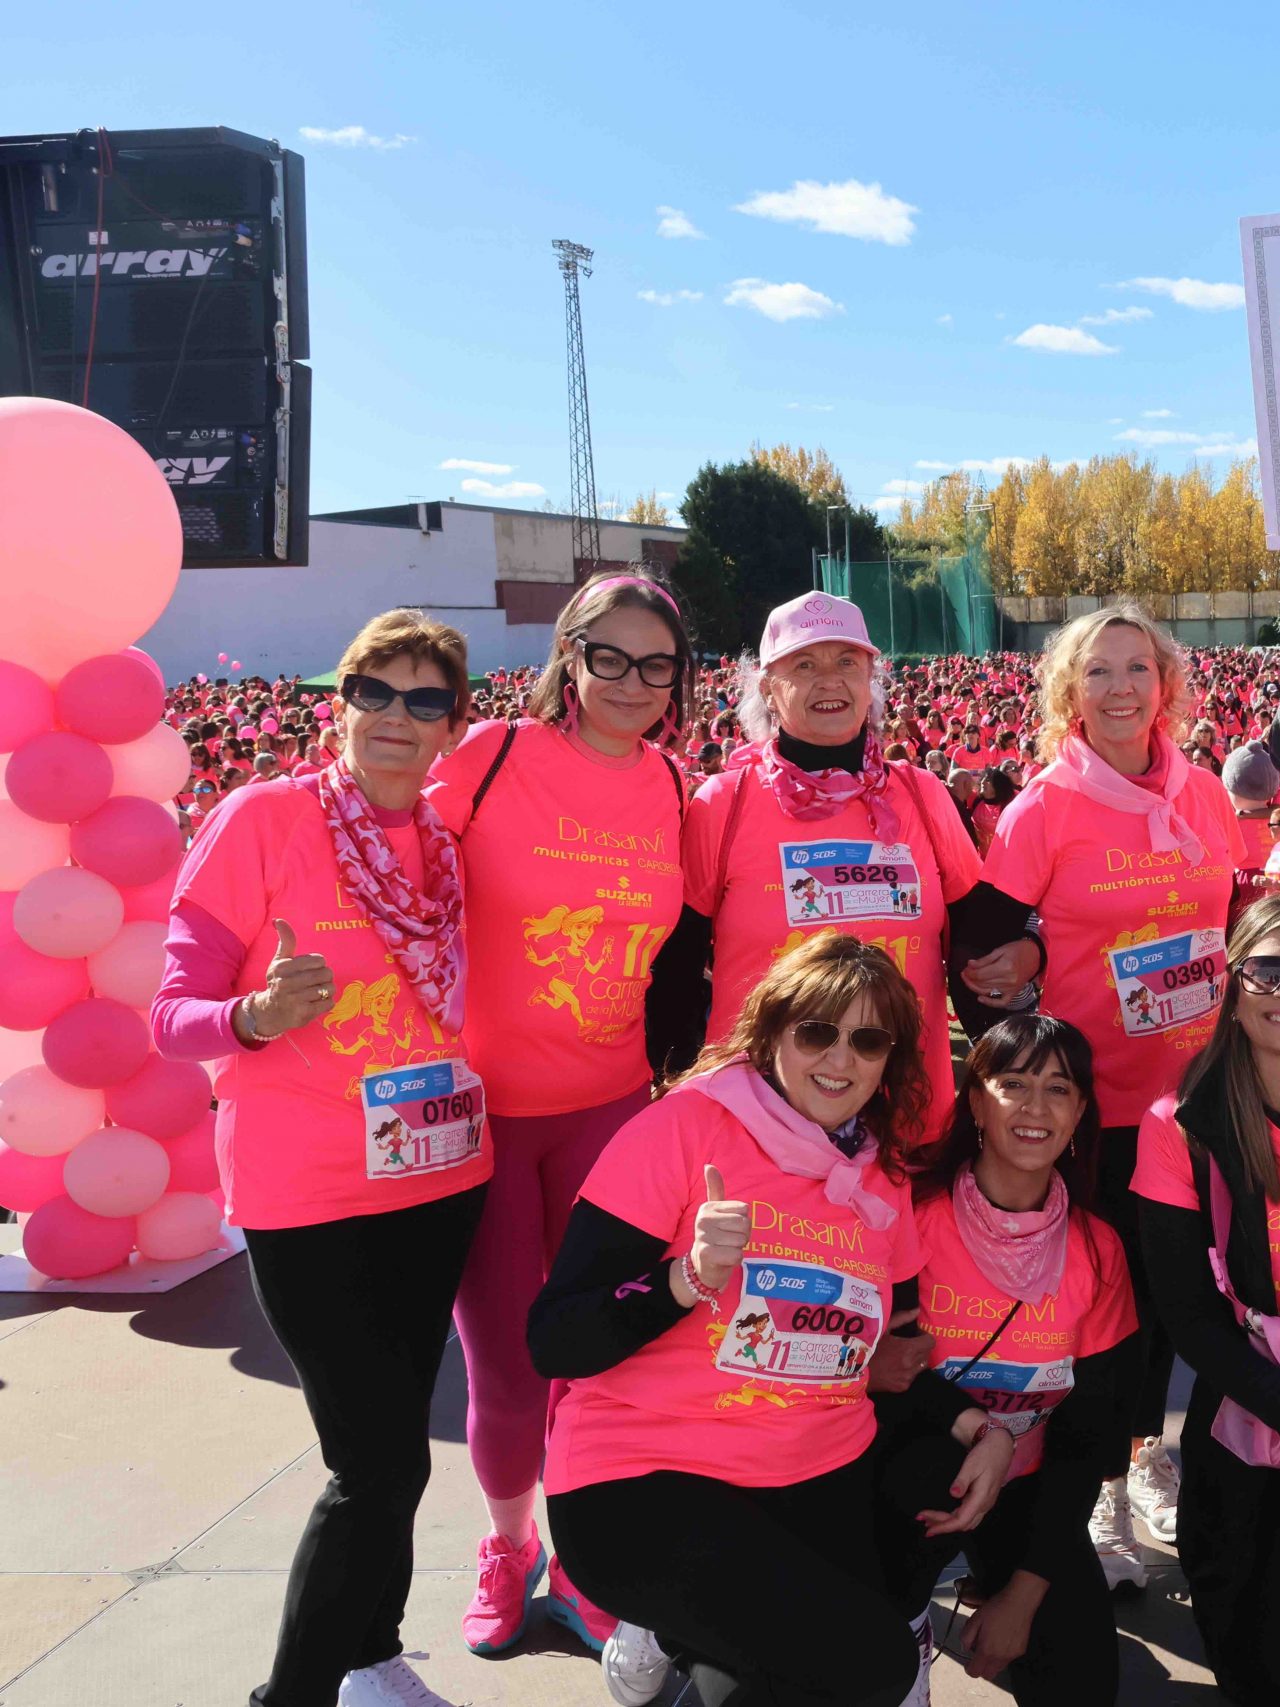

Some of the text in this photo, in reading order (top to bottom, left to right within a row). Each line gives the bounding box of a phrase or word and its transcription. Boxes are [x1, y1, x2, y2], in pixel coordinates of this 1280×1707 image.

[41, 247, 228, 278] array
[558, 815, 667, 855] Drasanvi
[792, 849, 810, 864] hp
[833, 865, 899, 884] 5626
[595, 888, 652, 903] SUZUKI
[1146, 902, 1199, 916] SUZUKI
[1122, 955, 1140, 973] hp
[1162, 957, 1216, 990] 0390
[374, 1079, 397, 1100] hp
[422, 1091, 473, 1125] 0760
[751, 1200, 866, 1254] Drasanvi
[756, 1269, 777, 1291] hp
[791, 1305, 865, 1335] 6000
[799, 1340, 839, 1354] Carrera
[805, 1352, 838, 1365] Mujer
[982, 1389, 1047, 1412] 5772
